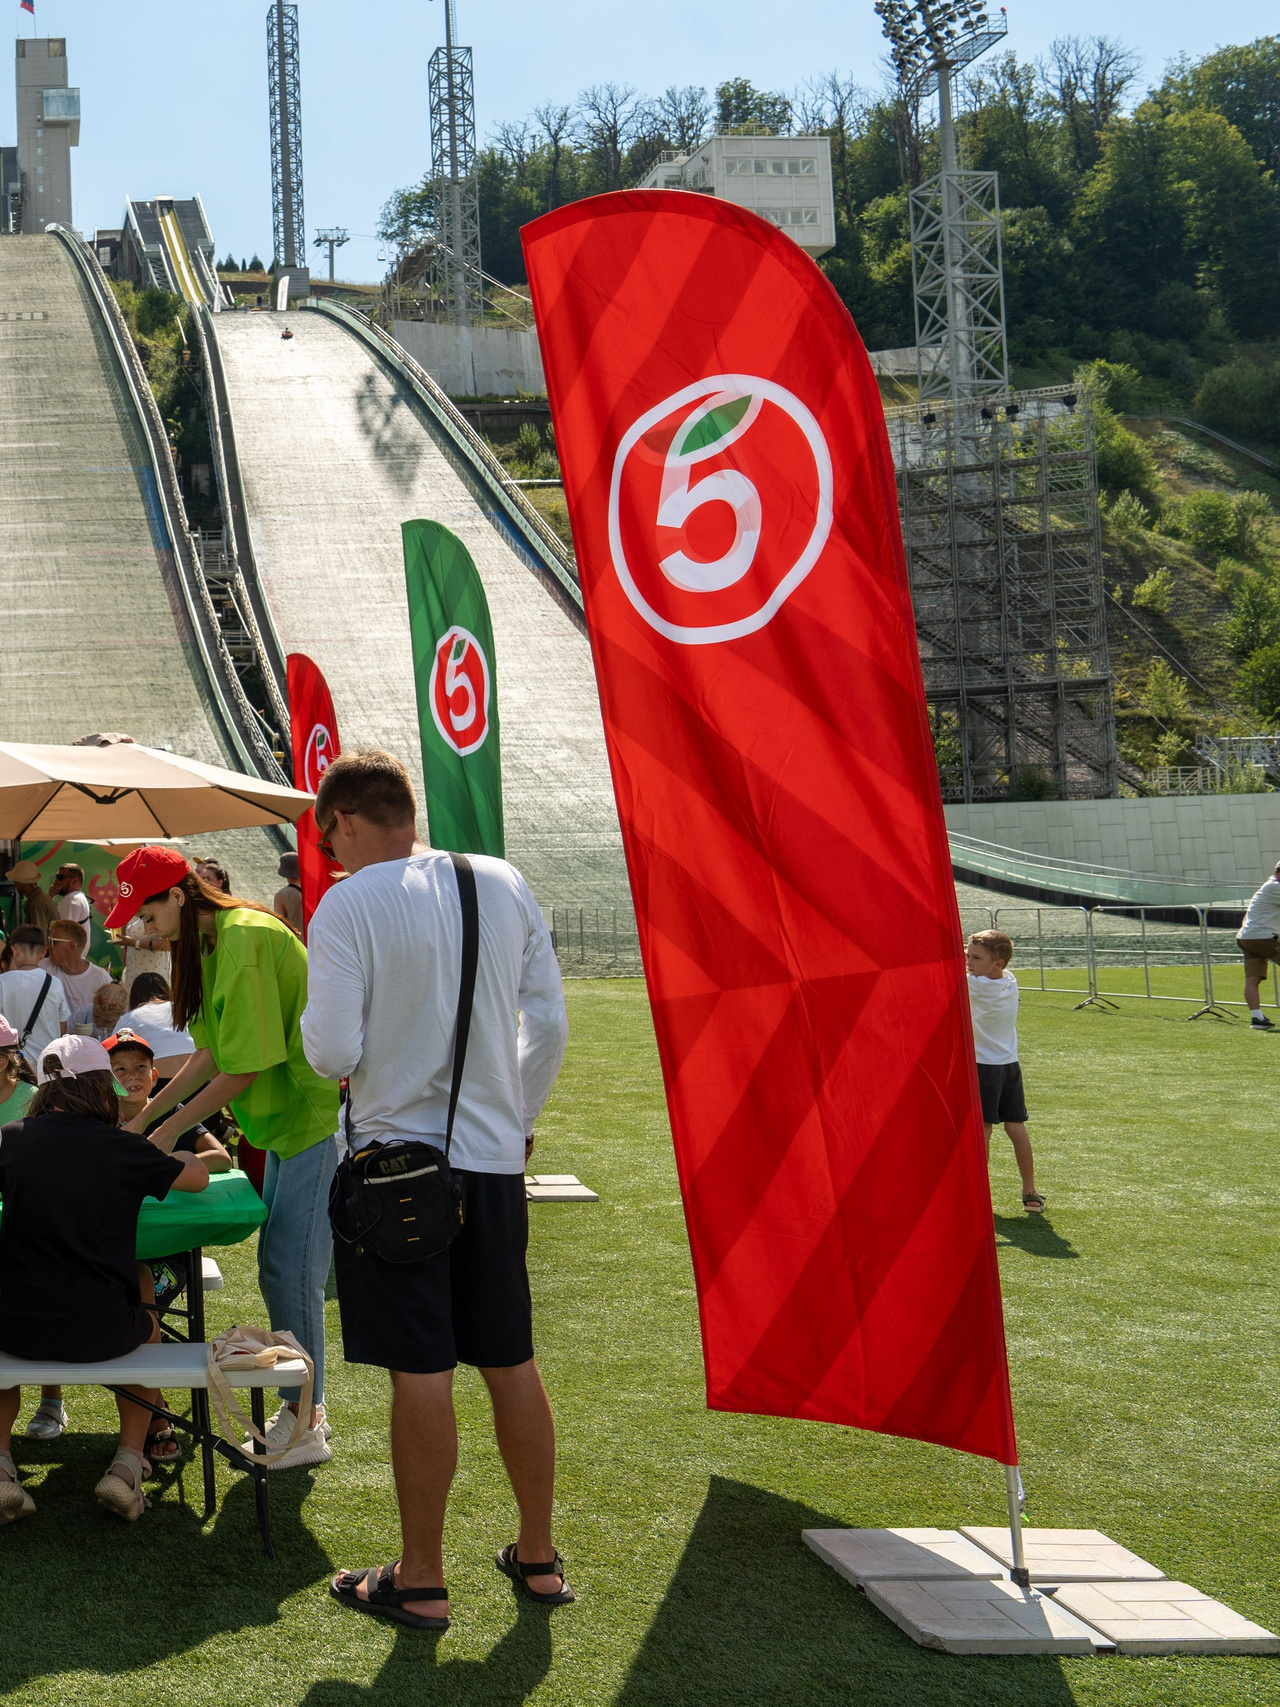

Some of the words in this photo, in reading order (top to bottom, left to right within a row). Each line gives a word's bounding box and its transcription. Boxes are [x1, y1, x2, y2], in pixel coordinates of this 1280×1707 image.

[656, 389, 762, 592] 5
[445, 634, 476, 732] 5
[378, 1156, 408, 1174] CAT
